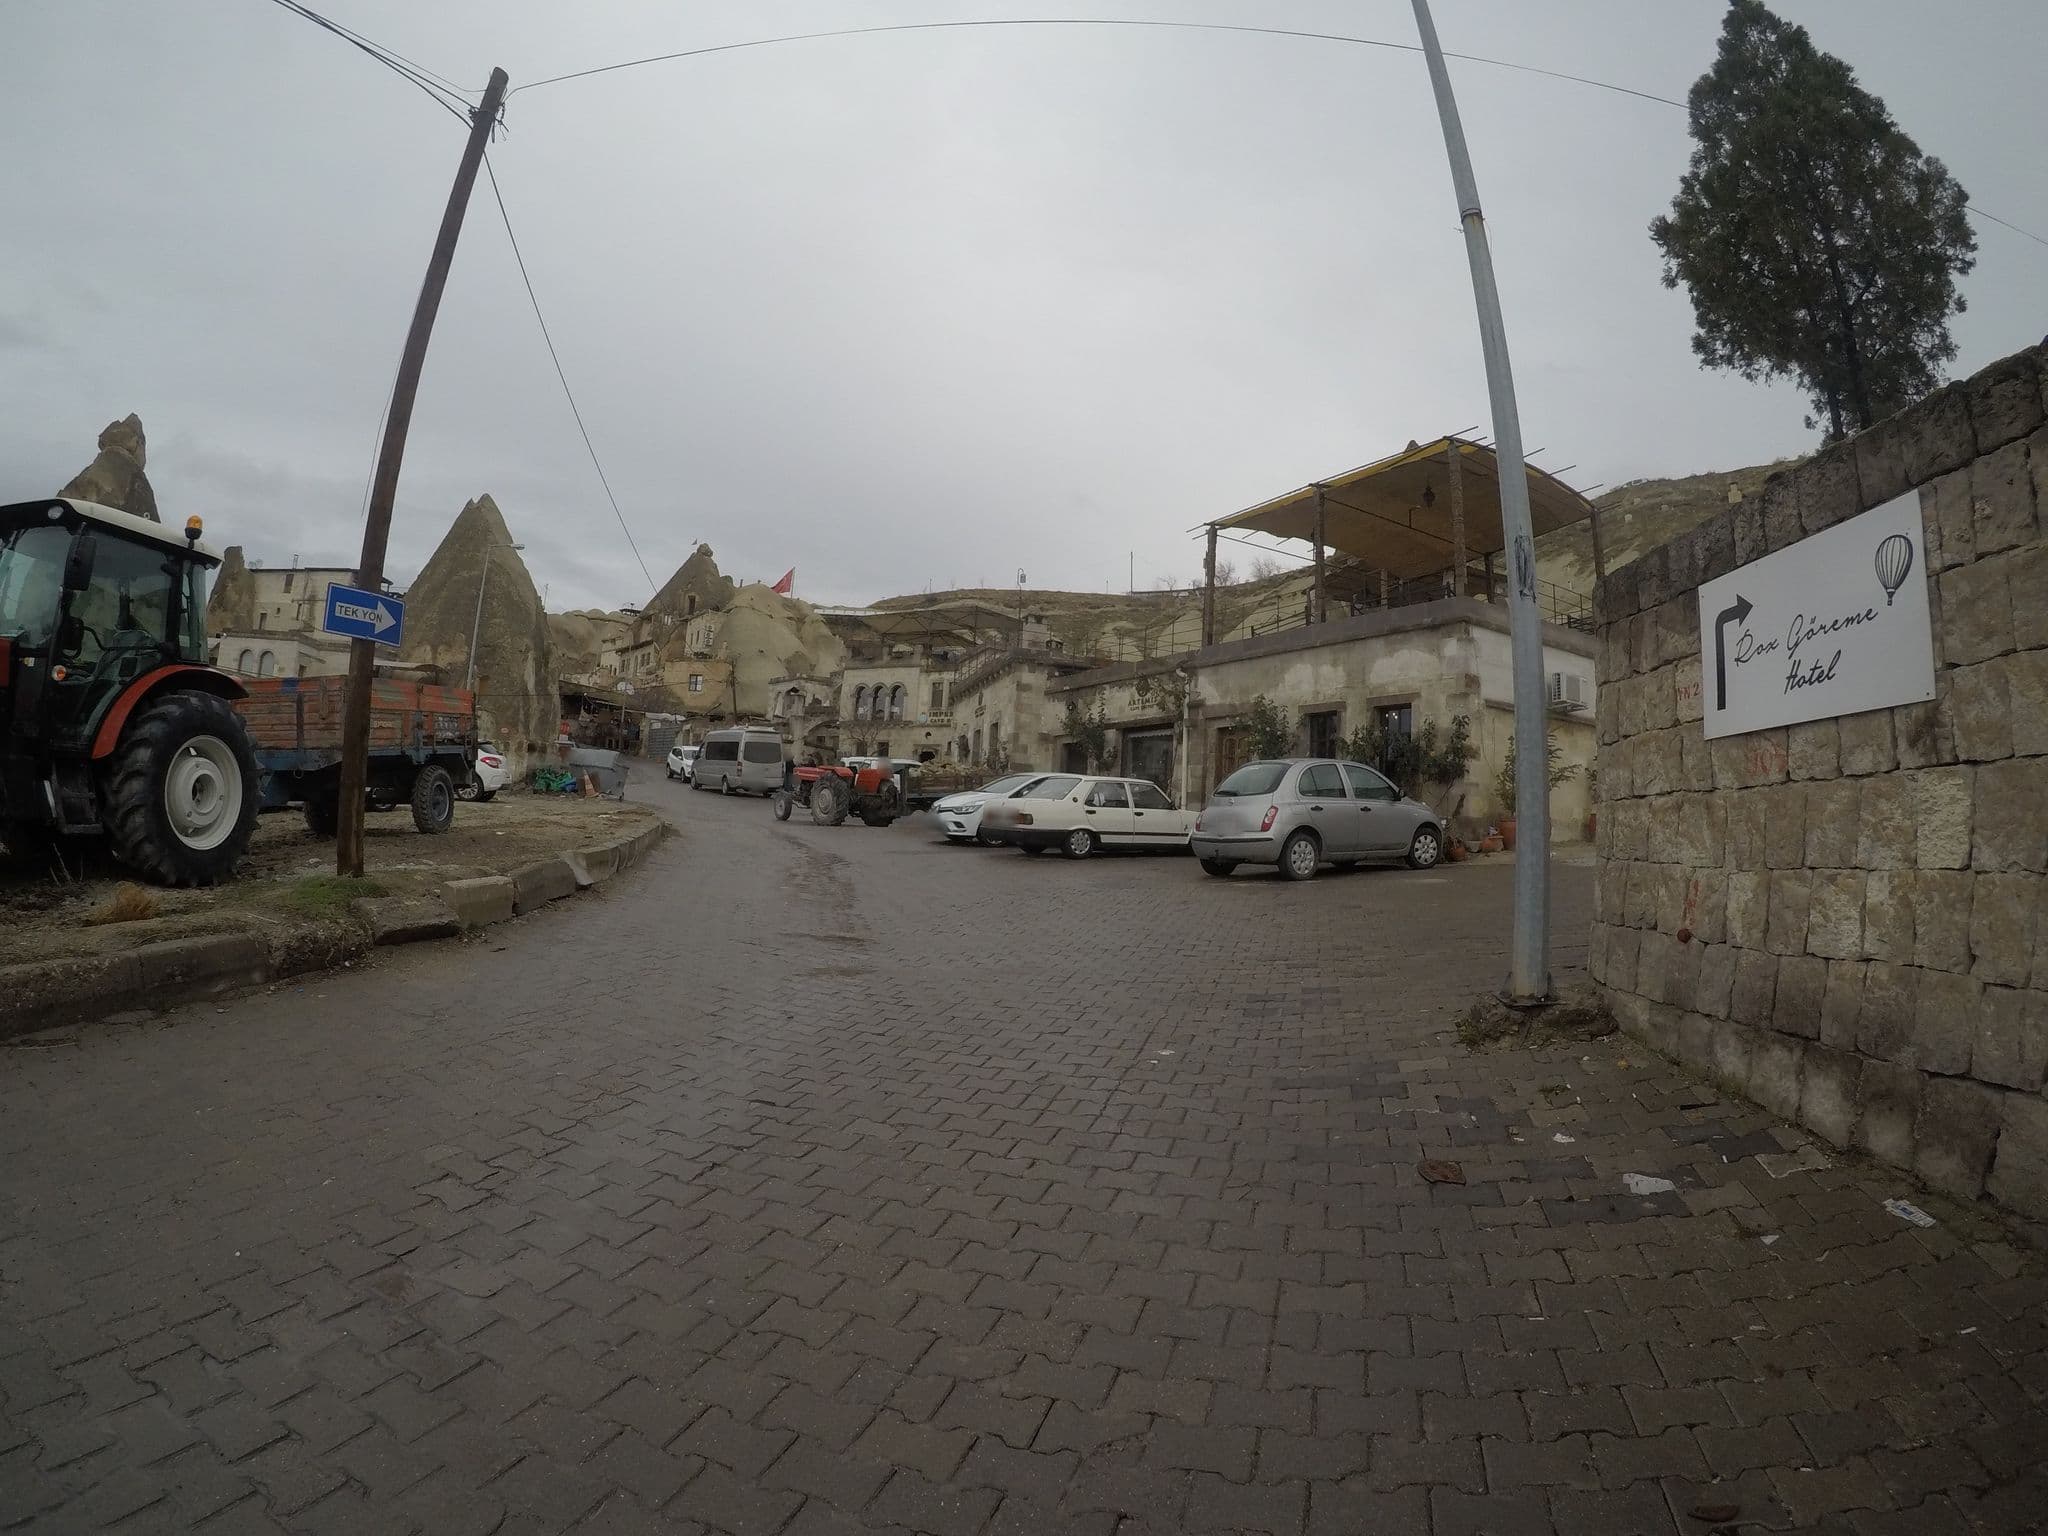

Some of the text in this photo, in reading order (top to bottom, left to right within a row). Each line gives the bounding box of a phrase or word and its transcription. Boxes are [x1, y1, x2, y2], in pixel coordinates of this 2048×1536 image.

[338, 604, 359, 618] TEK
[1734, 608, 1879, 667] Rox Göreme
[1784, 649, 1842, 695] Hotel
